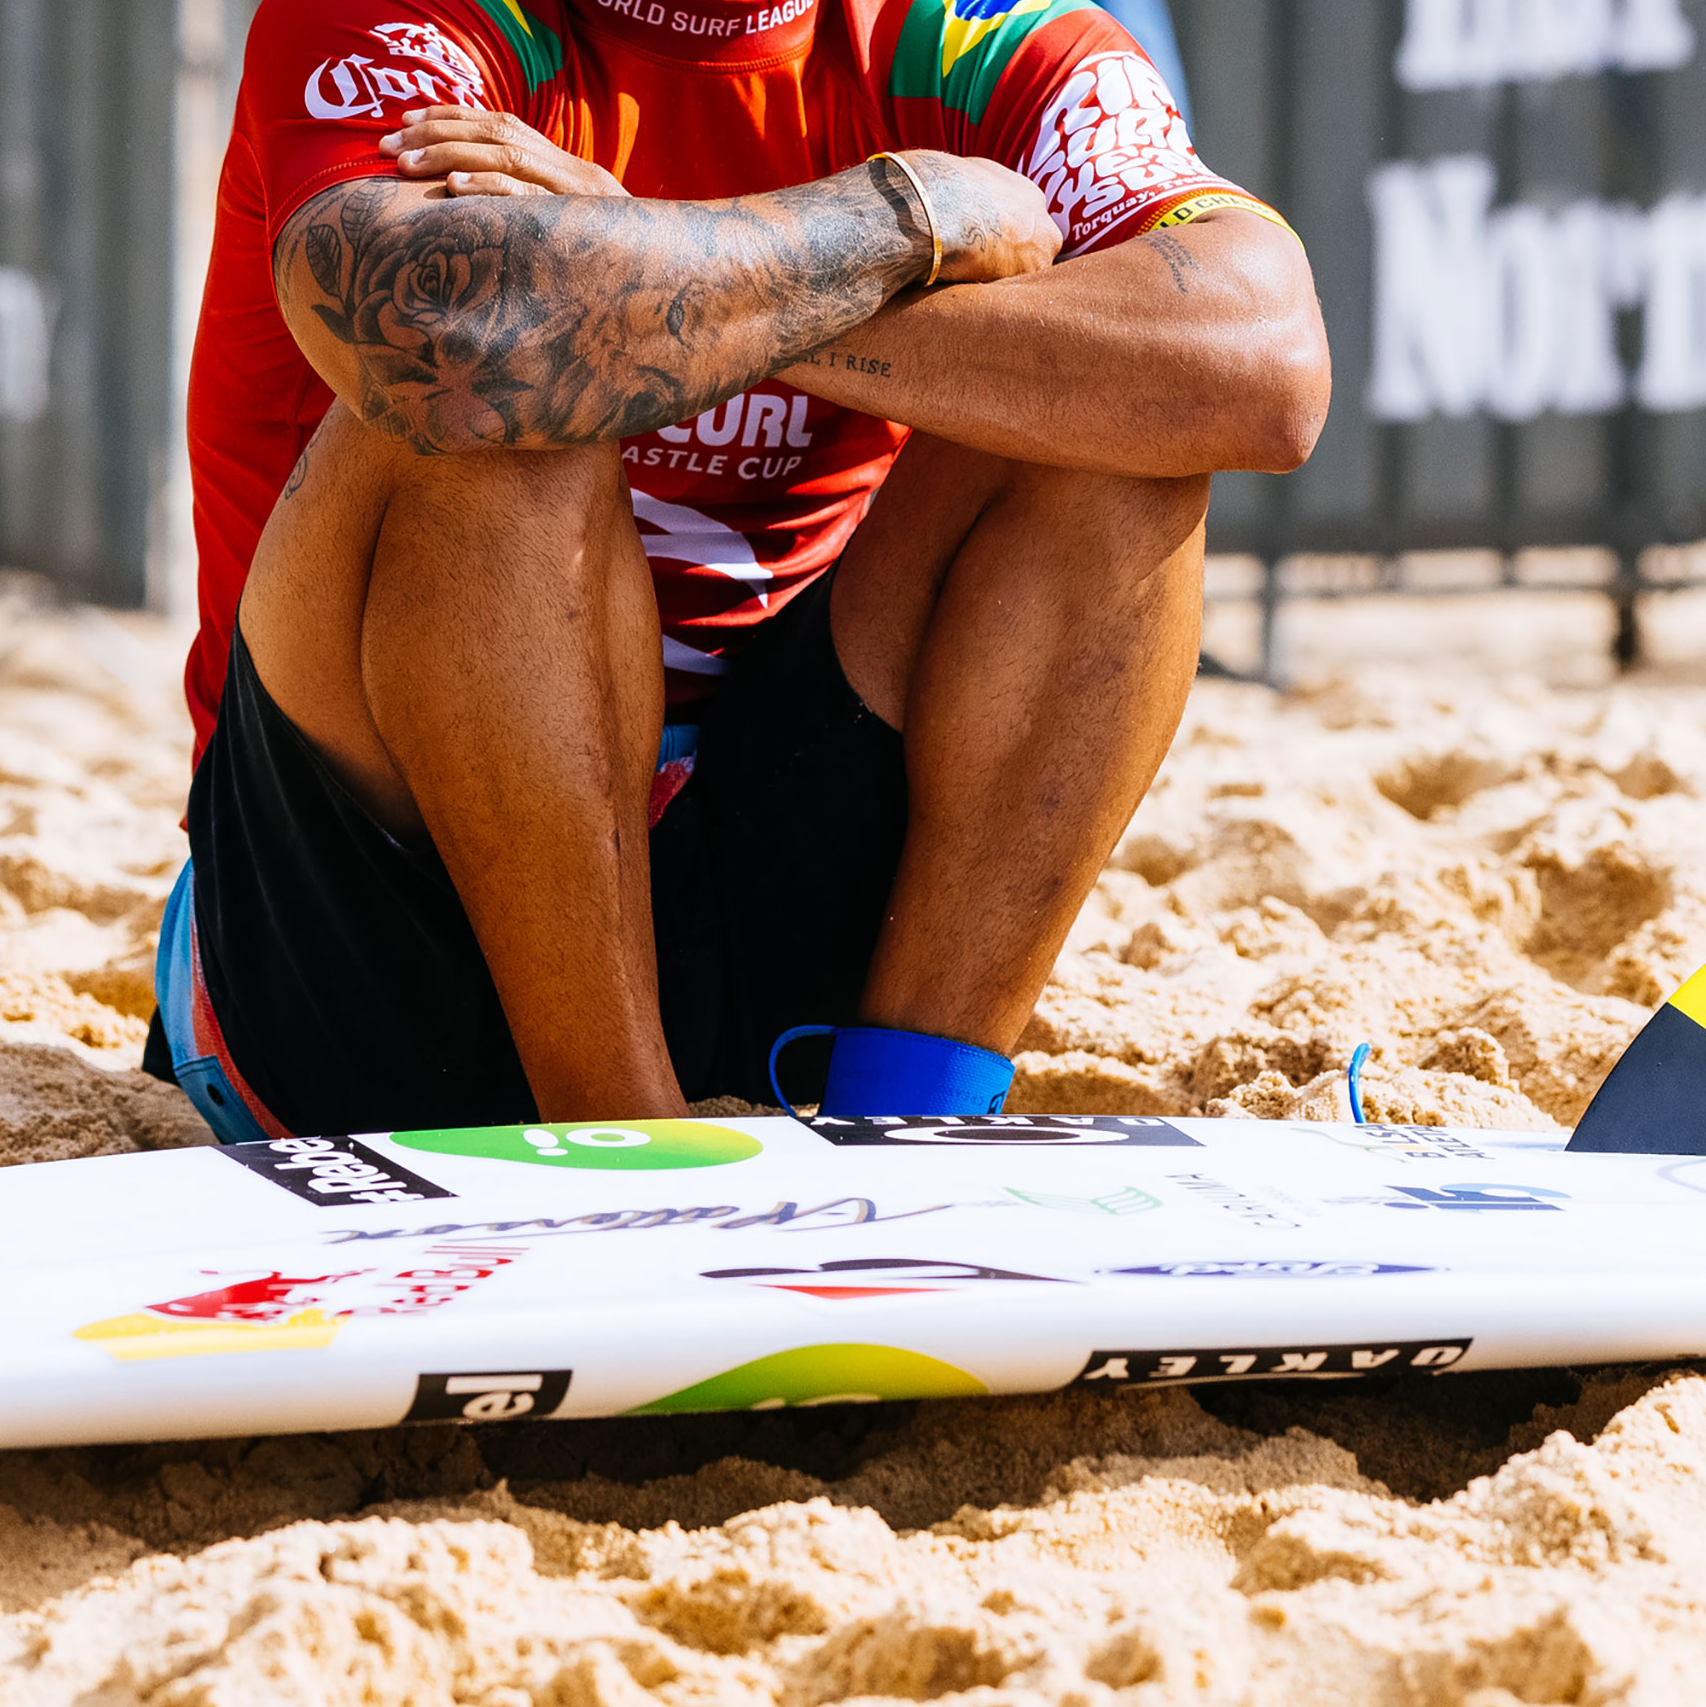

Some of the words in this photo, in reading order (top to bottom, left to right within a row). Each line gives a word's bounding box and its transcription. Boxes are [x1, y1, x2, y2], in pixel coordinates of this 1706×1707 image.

[671, 10, 741, 37] SURF
[1072, 189, 1155, 242] Torquay,
[845, 353, 893, 379] RISE
[621, 445, 728, 476] ASTLE
[737, 455, 803, 481] CUP
[809, 1116, 1166, 1127] OAKLEY
[269, 1137, 425, 1203] #Rebe
[1084, 1346, 1464, 1380] OAKLEY
